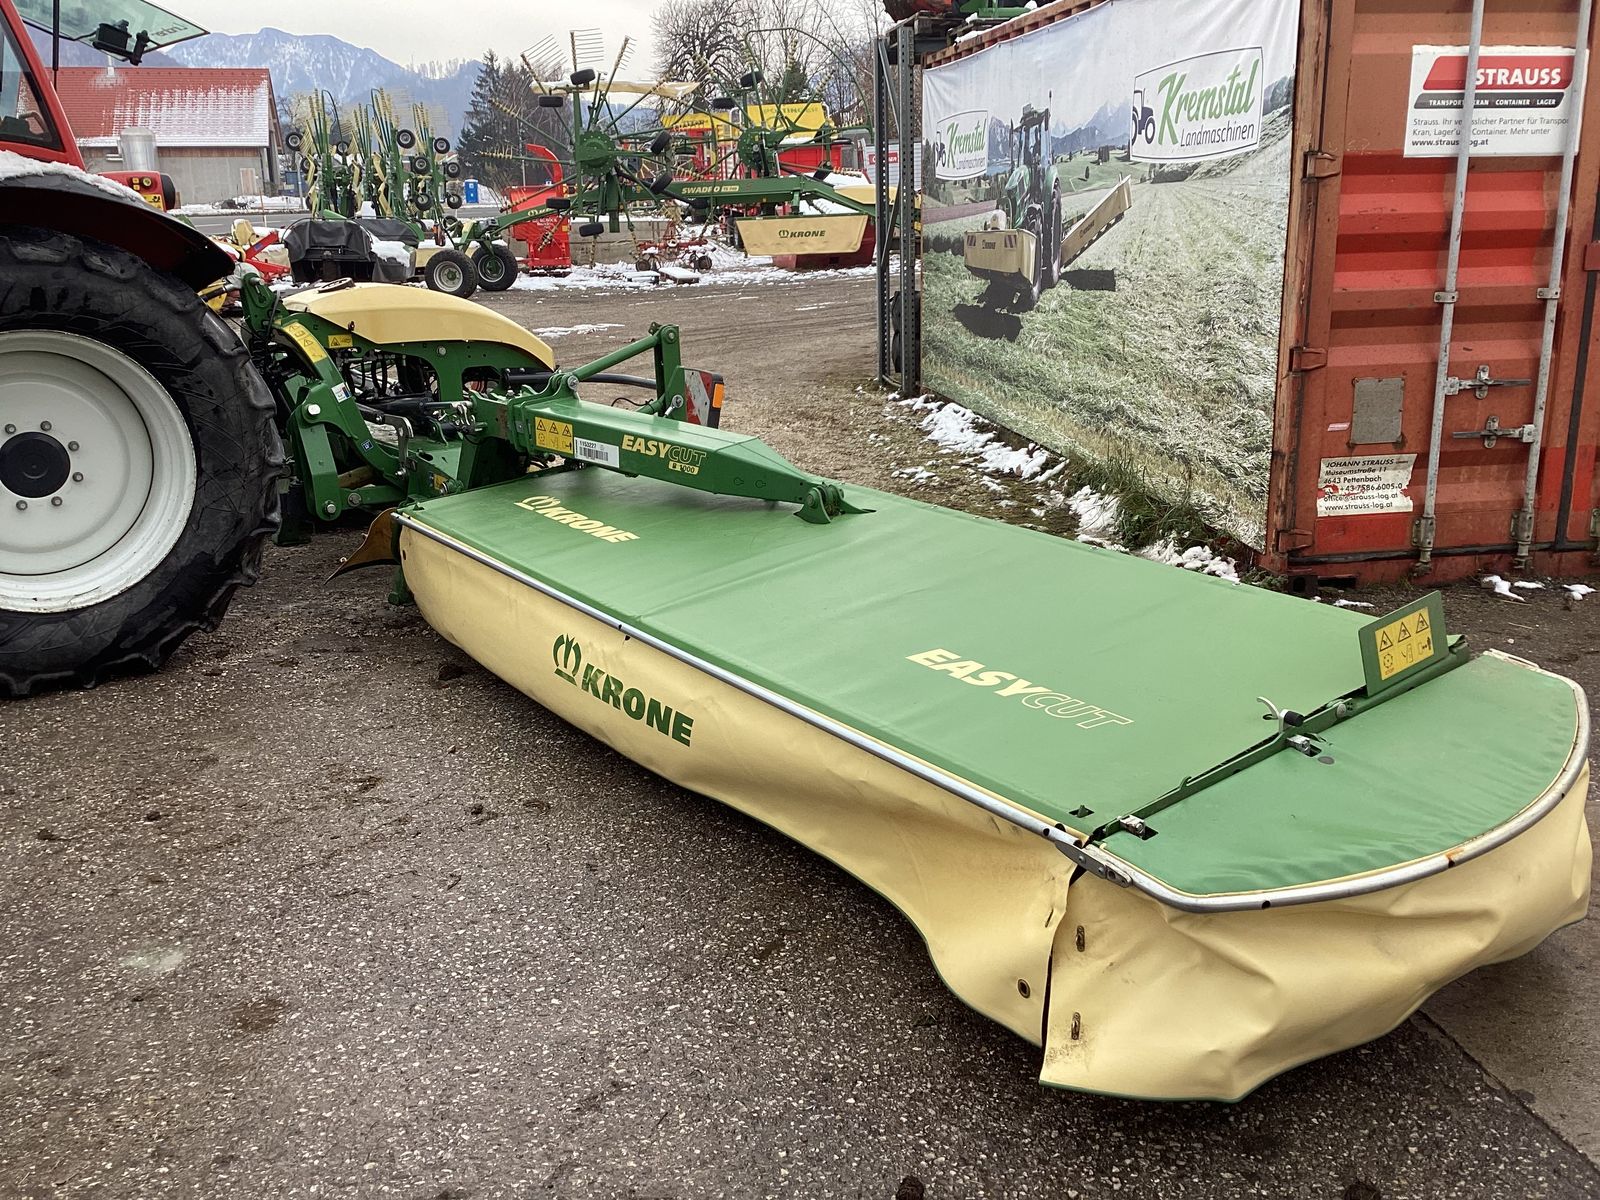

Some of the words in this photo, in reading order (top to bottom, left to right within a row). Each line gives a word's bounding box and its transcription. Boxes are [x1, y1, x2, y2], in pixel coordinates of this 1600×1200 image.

[1475, 68, 1561, 86] STRAUSS
[1158, 58, 1260, 145] Kremstal
[1429, 99, 1464, 107] TRANSPOR
[1442, 117, 1452, 125] Ihr
[1454, 117, 1498, 126] vesslicher
[1499, 117, 1525, 125] Partner
[1527, 117, 1537, 125] für
[1180, 120, 1255, 147] Landmaschinen
[1433, 129, 1455, 137] Lager
[947, 118, 986, 168] Kremstal
[1412, 138, 1488, 147] www.strausog.at
[790, 230, 826, 238] KRONE
[621, 434, 707, 467] EASYCUT
[1326, 460, 1361, 468] JOHANN
[1361, 458, 1394, 466] STRAUSS
[1324, 501, 1393, 511] www.strauss-log.at
[543, 506, 640, 543] KRONE
[905, 648, 1134, 730] EASYCUT
[581, 662, 694, 747] KRONE
